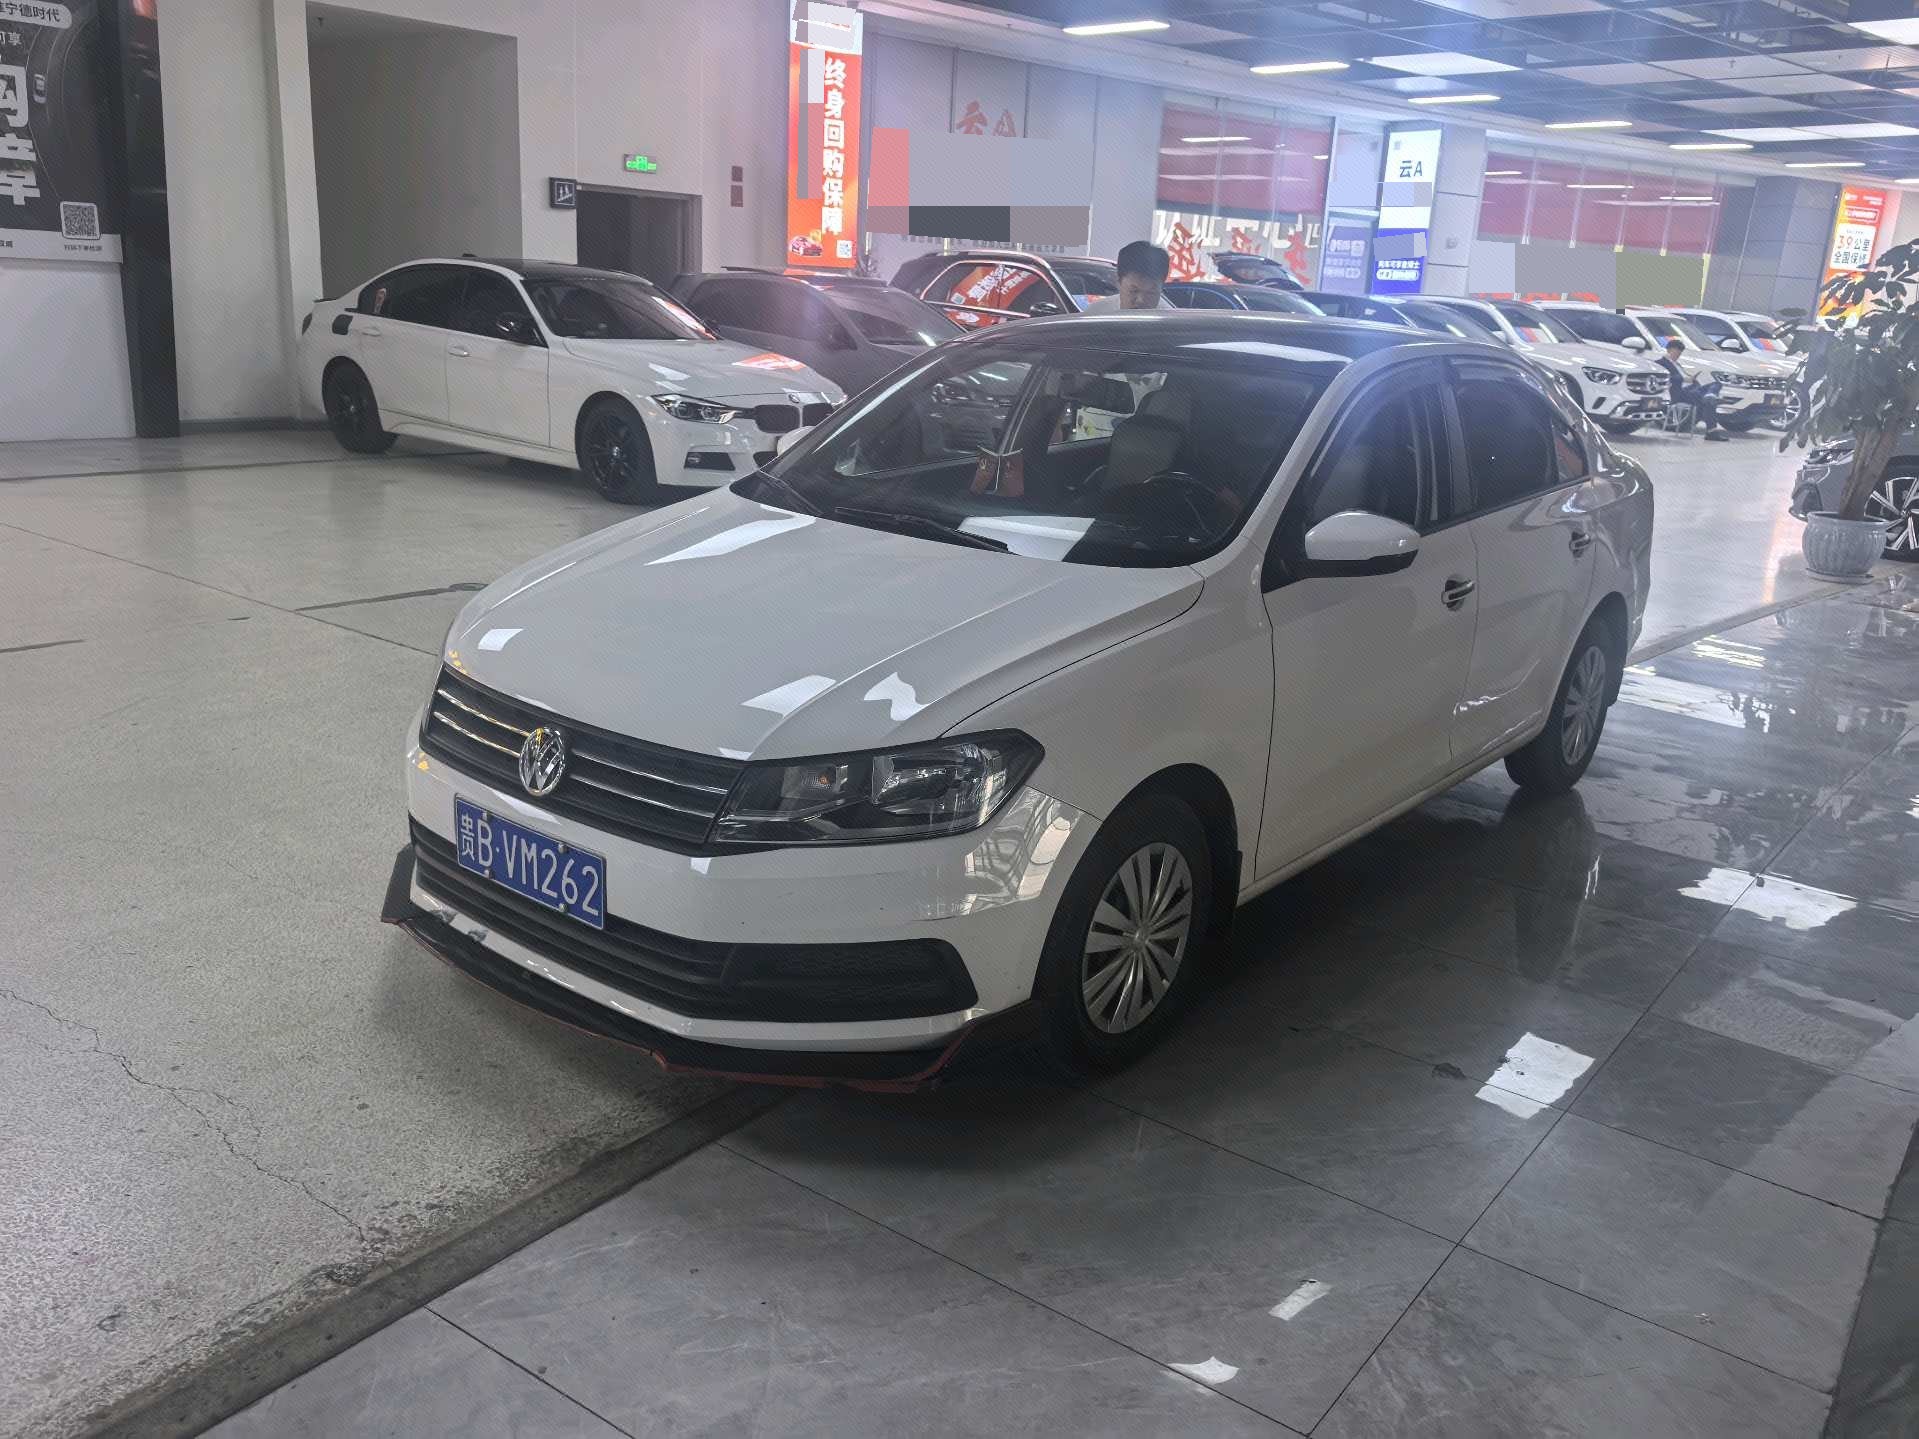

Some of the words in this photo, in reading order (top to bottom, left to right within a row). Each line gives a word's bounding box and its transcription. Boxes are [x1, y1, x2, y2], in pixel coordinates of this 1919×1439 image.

[821, 57, 847, 236] 终身回购保障
[1399, 159, 1424, 178] 云A
